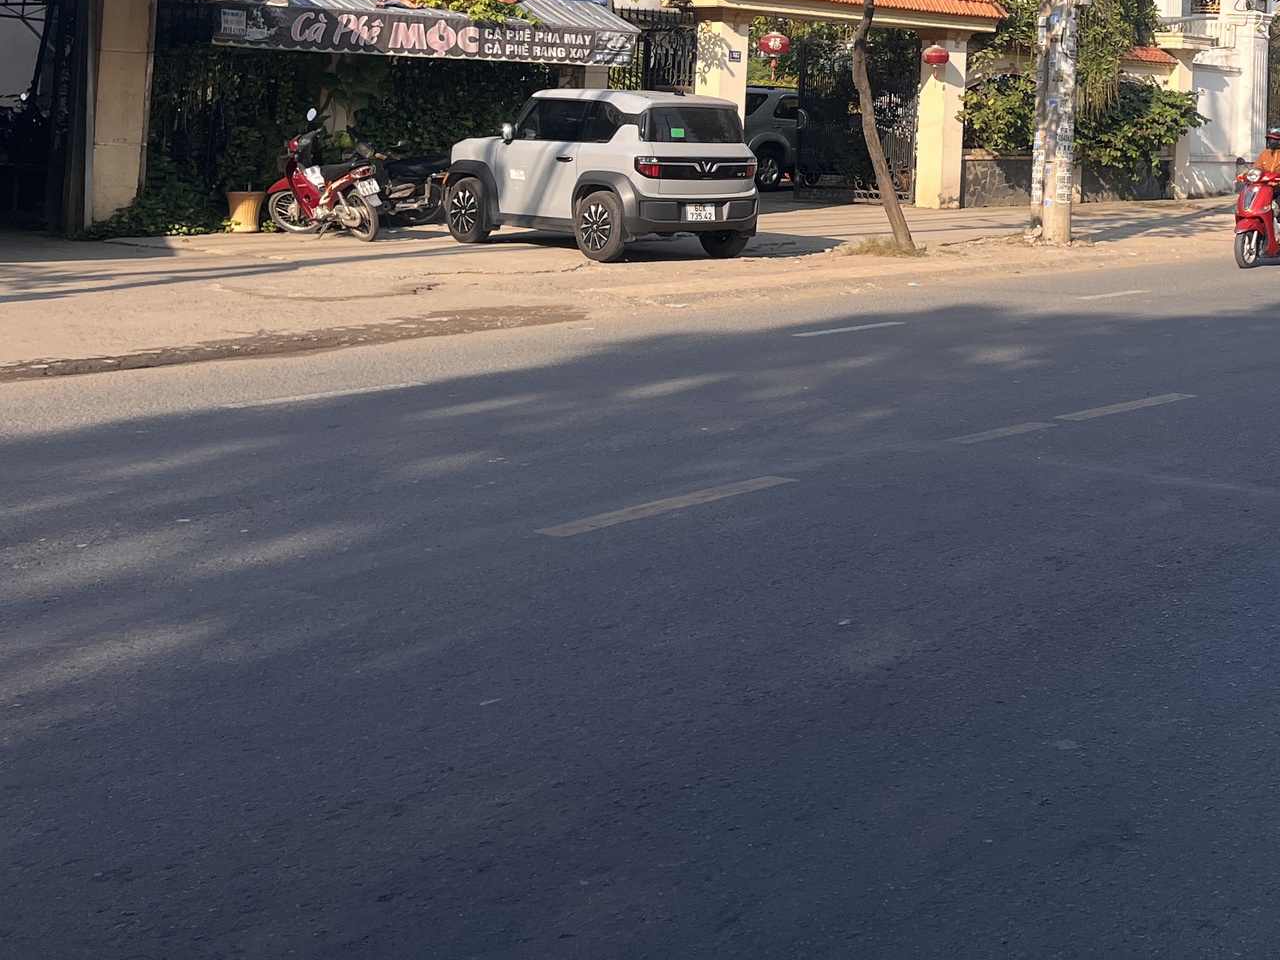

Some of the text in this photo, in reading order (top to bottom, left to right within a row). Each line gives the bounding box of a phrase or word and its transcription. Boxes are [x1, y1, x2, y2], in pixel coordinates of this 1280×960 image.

[291, 12, 480, 57] Cà Phê MỘC
[506, 29, 532, 42] PHÊ
[534, 31, 561, 44] PHA
[563, 32, 592, 46] MÁY
[484, 42, 502, 55] CÀ
[505, 43, 530, 56] PHÊ
[532, 46, 566, 58] RANG
[569, 47, 591, 59] XAY
[689, 212, 713, 220] 735.42
[695, 204, 707, 212] 60K
